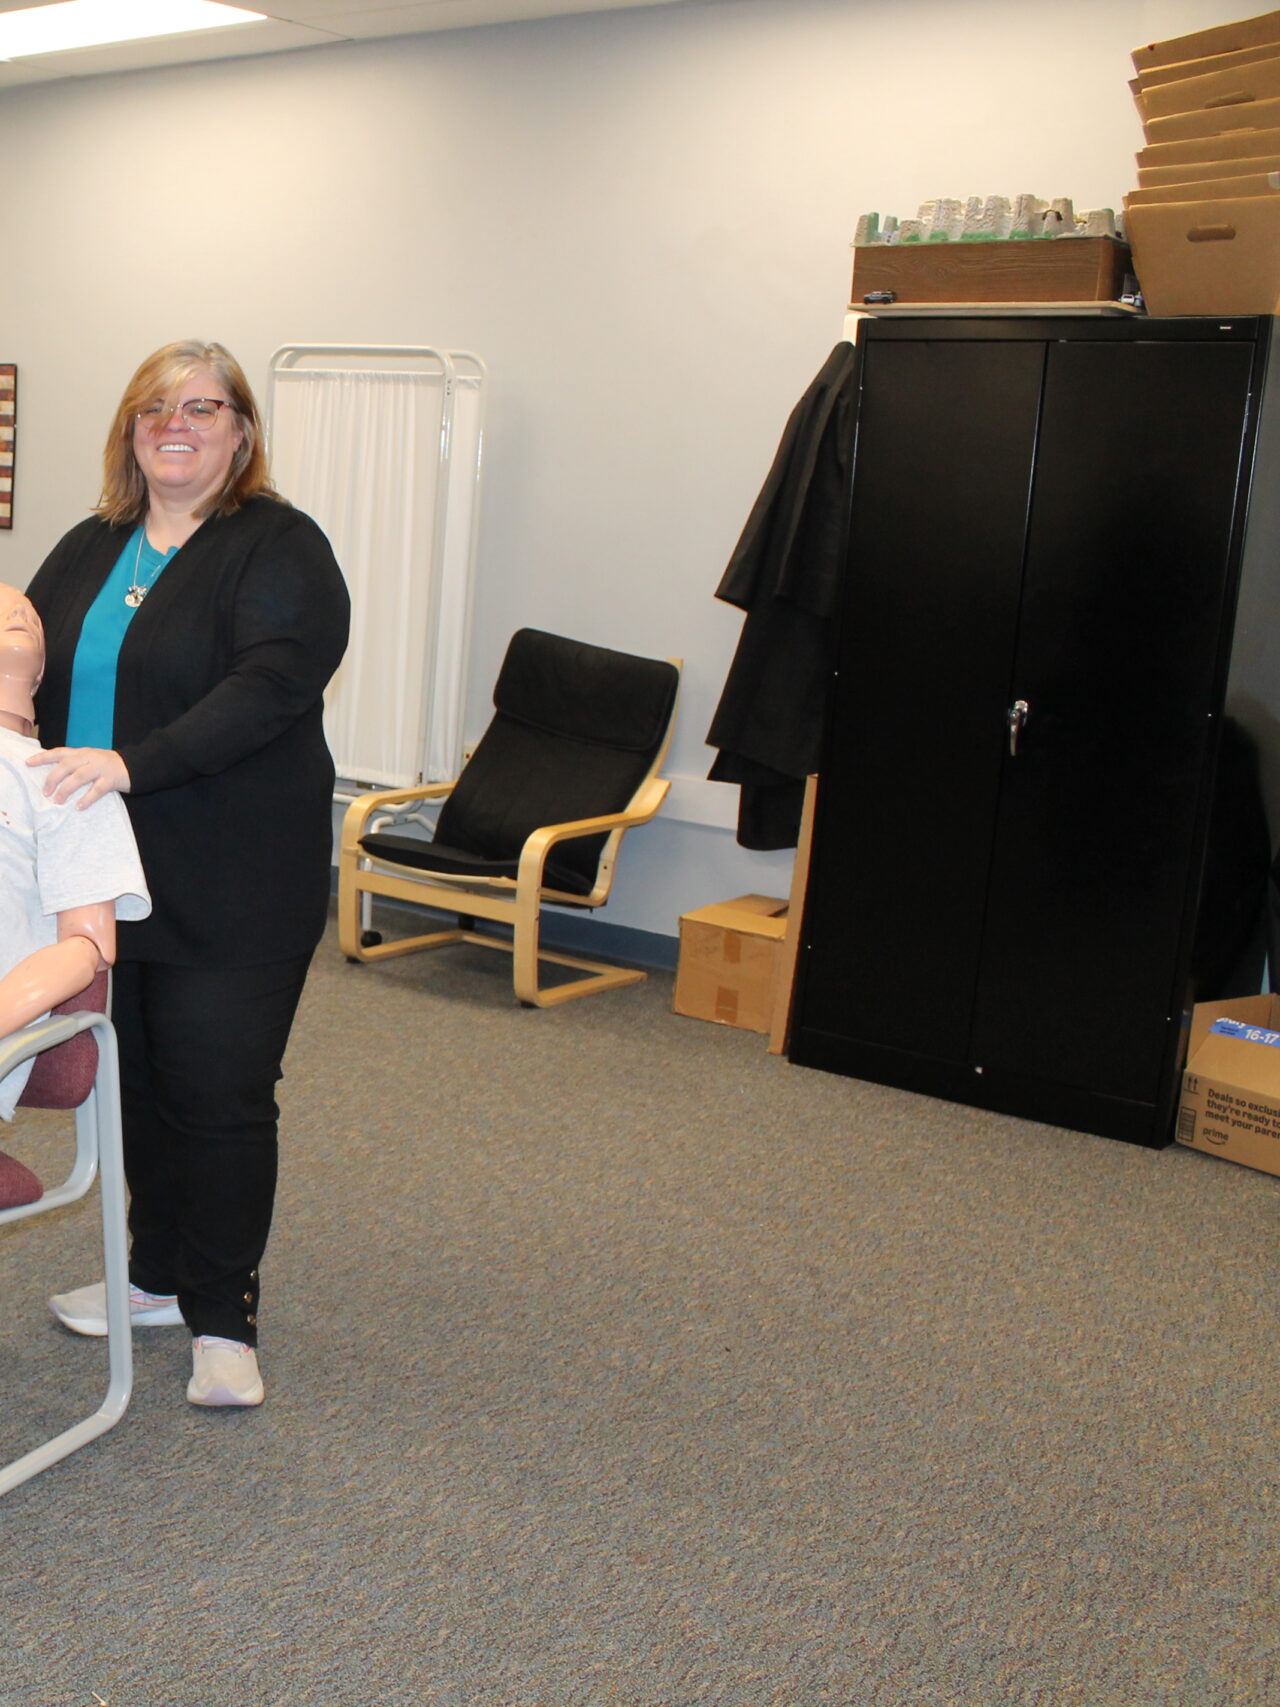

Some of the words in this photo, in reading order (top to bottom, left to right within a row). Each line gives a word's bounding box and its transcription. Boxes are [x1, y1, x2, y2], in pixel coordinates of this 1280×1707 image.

[1245, 1029, 1280, 1044] 16-17
[1208, 1088, 1233, 1103] Deals
[1235, 1098, 1247, 1108] so
[1205, 1110, 1230, 1124] meet
[1231, 1118, 1254, 1131] your
[1207, 1100, 1241, 1116] they're
[1242, 1110, 1271, 1127] ready
[1203, 1128, 1229, 1141] prime
